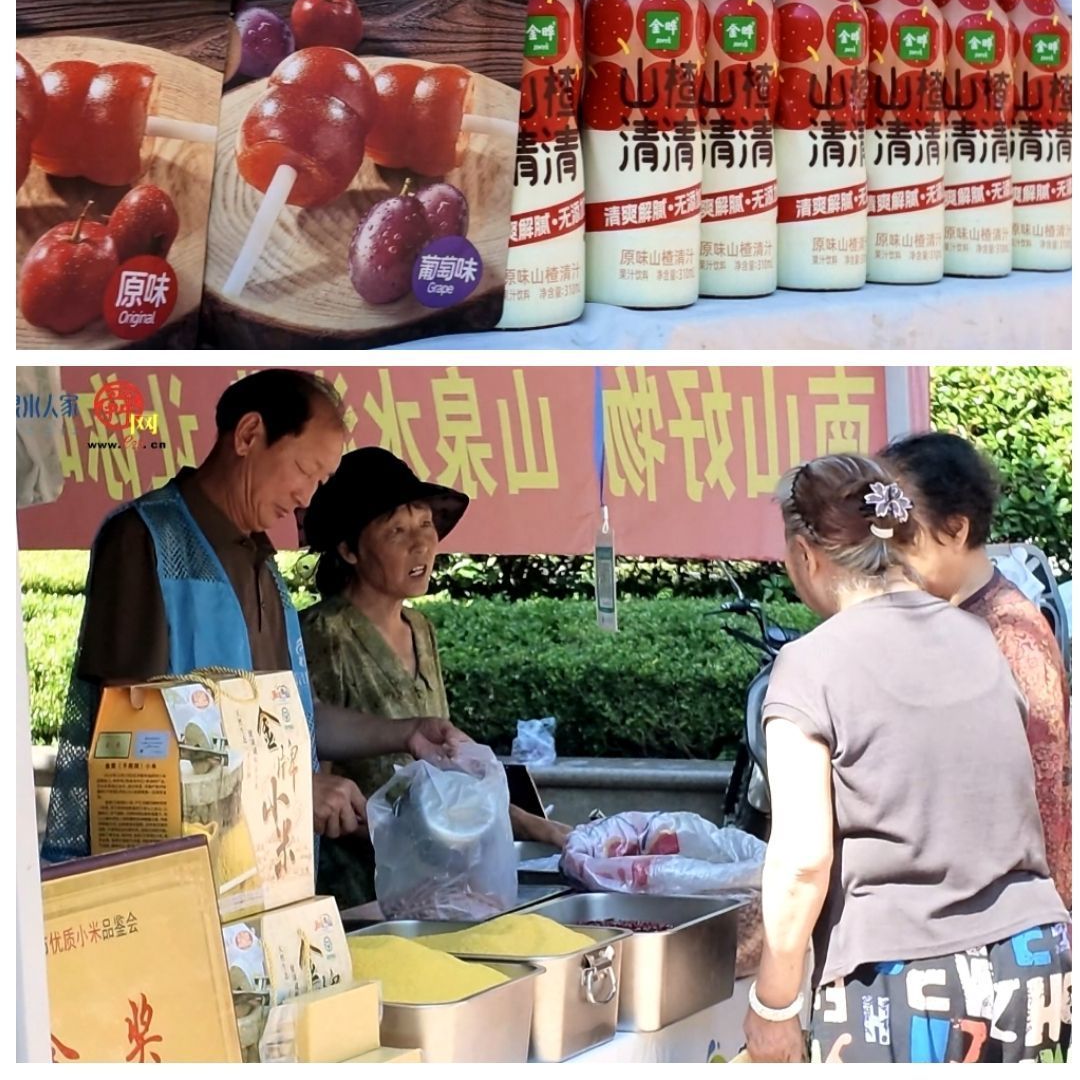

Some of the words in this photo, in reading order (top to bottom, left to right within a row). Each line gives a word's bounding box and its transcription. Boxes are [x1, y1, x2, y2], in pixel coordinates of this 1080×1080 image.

[619, 117, 698, 172] 清清
[417, 254, 478, 284] 葡萄味
[114, 270, 172, 309] 原味
[426, 281, 456, 296] Grape
[117, 309, 157, 327] Original
